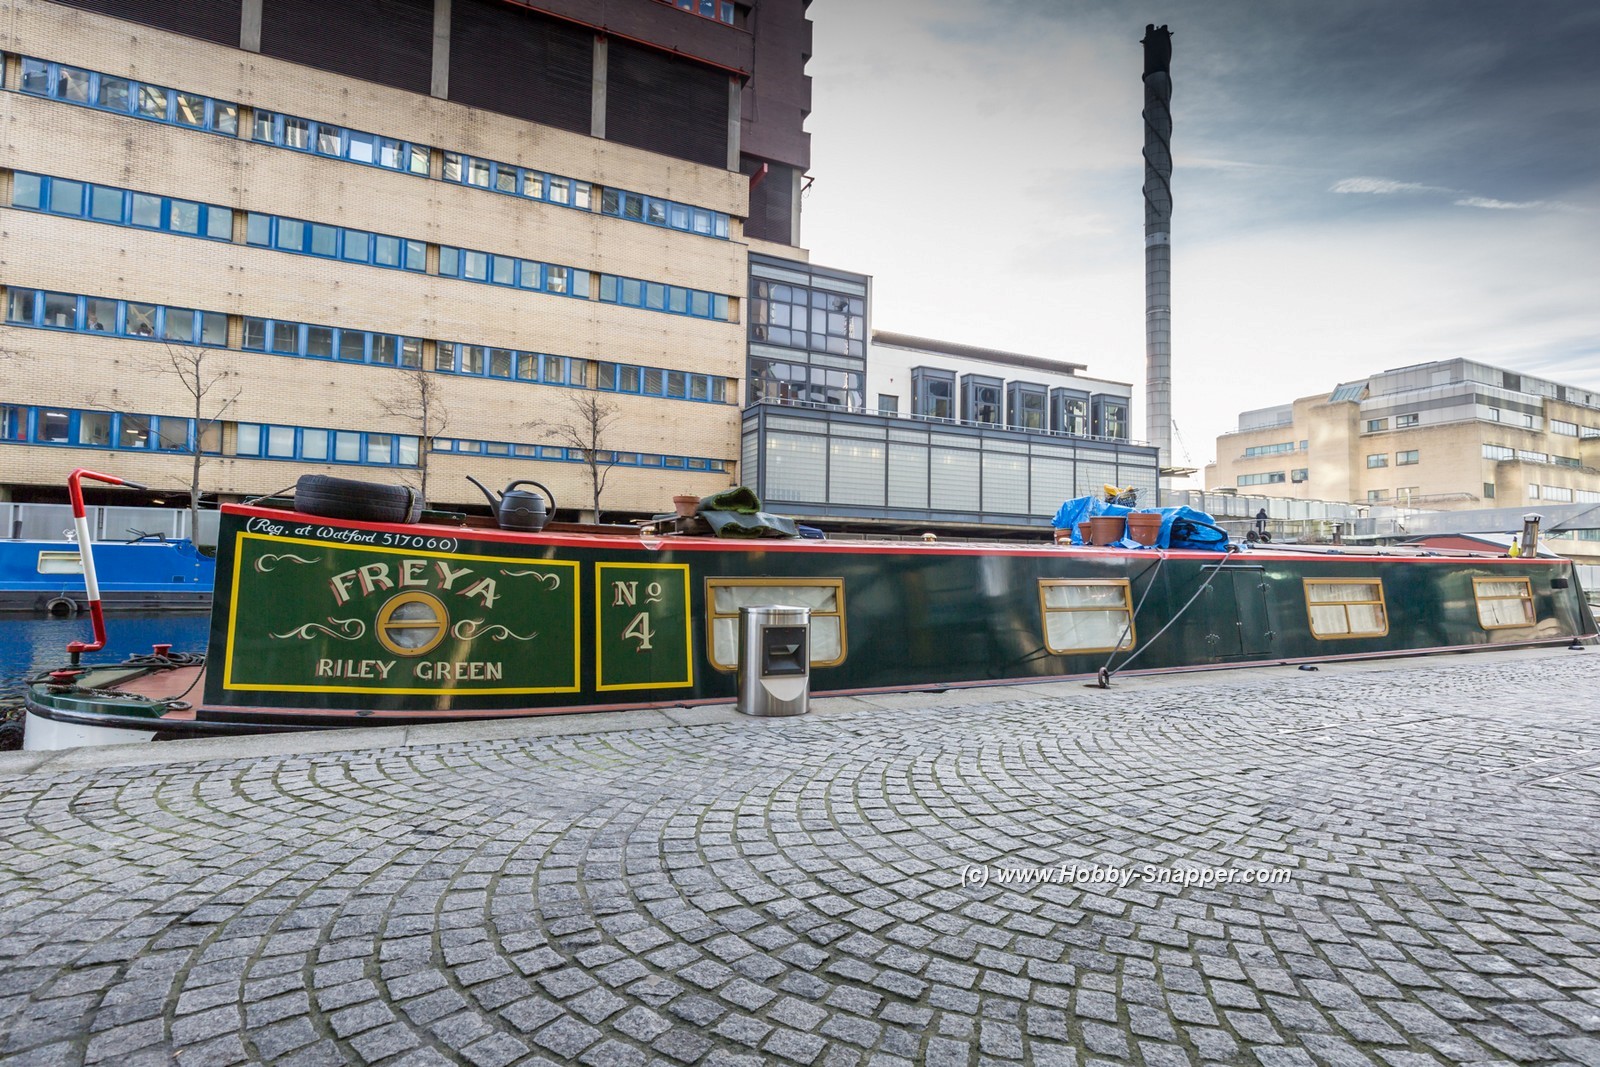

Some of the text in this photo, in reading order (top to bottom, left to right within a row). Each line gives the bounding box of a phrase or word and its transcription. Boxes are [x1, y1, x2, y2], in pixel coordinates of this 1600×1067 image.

[246, 517, 459, 554] (Reg. at Watford 517060)
[329, 559, 502, 609] FREYA
[621, 612, 656, 652] 4
[316, 658, 502, 681] RILEY GREEN
